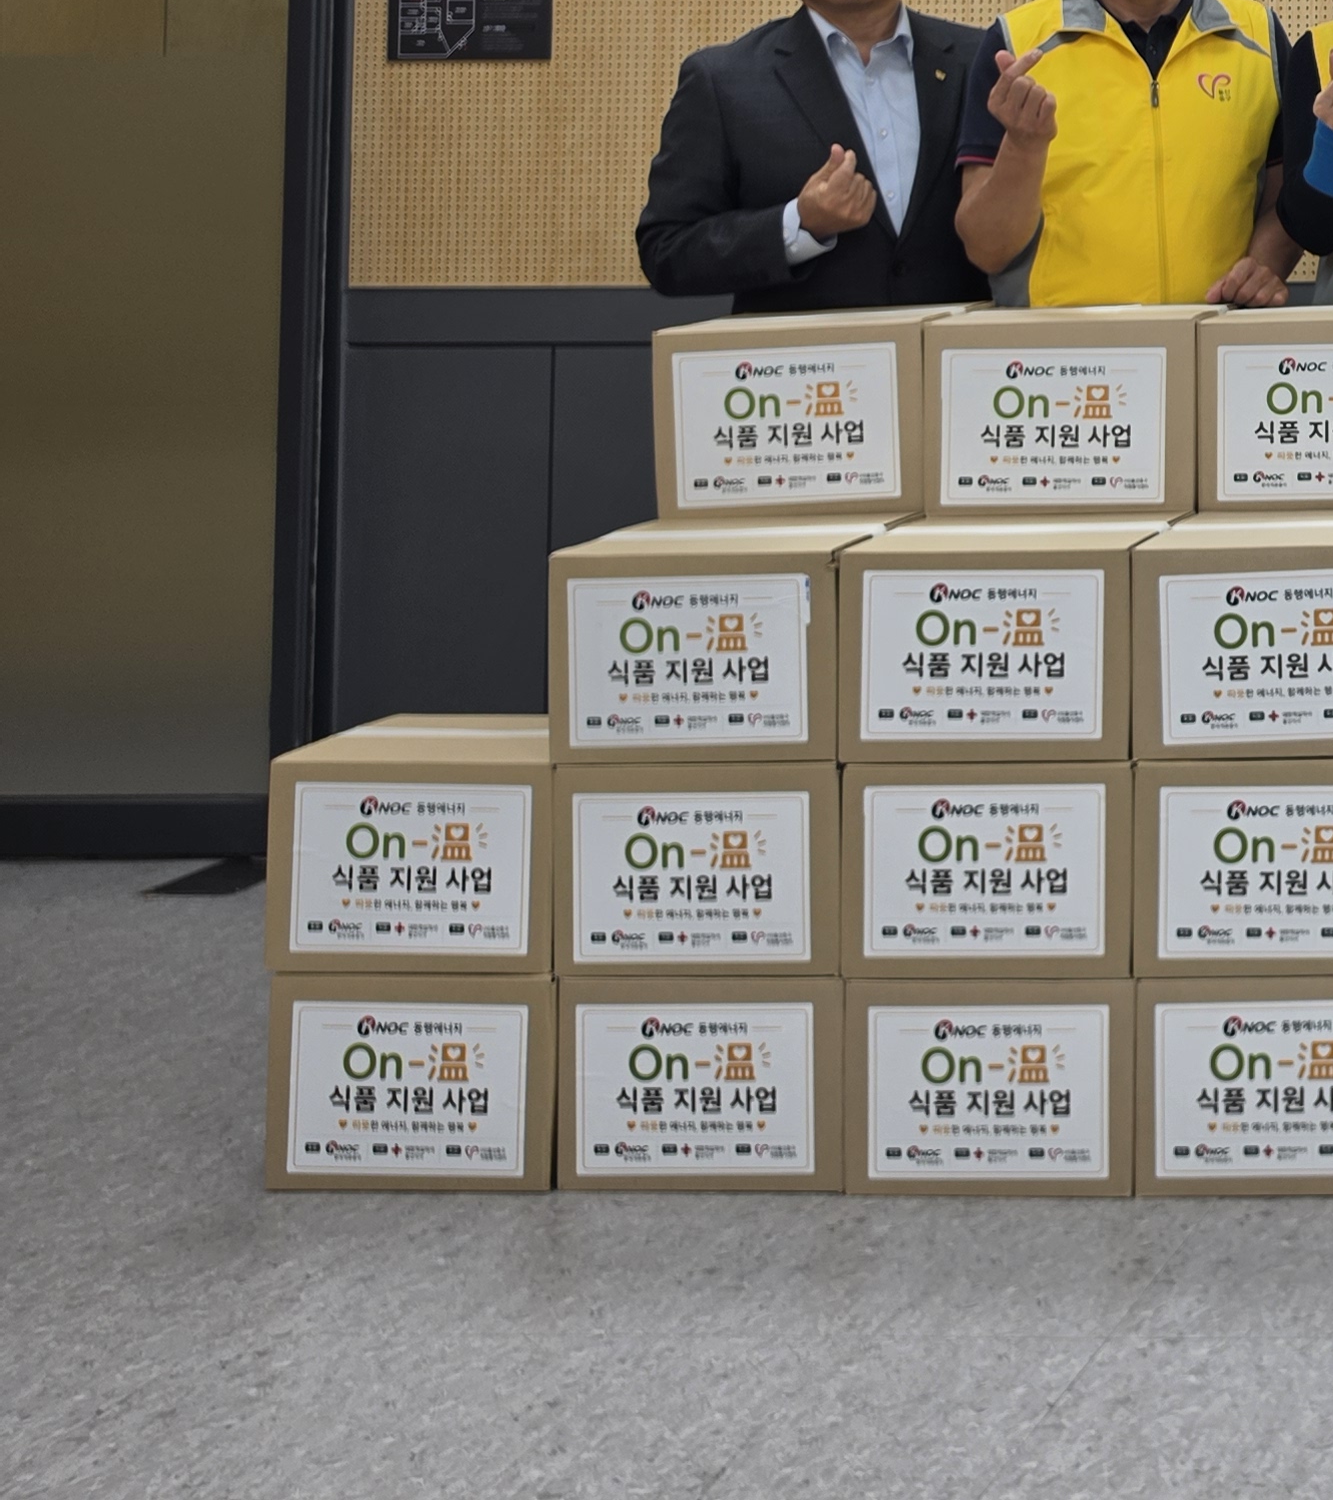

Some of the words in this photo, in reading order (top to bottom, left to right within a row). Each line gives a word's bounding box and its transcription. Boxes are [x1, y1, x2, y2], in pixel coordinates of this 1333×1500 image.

[1278, 356, 1327, 375] KNOC
[1254, 420, 1300, 444] 식품
[1226, 799, 1280, 820] KNOC
[331, 865, 380, 891] 식품
[389, 866, 437, 891] 지원
[445, 867, 492, 892] 사업
[1200, 870, 1249, 896] 식품
[1259, 869, 1307, 895] 지원
[616, 1087, 664, 1113] 식품
[673, 1086, 721, 1112] 지원
[730, 1086, 776, 1112] 사업
